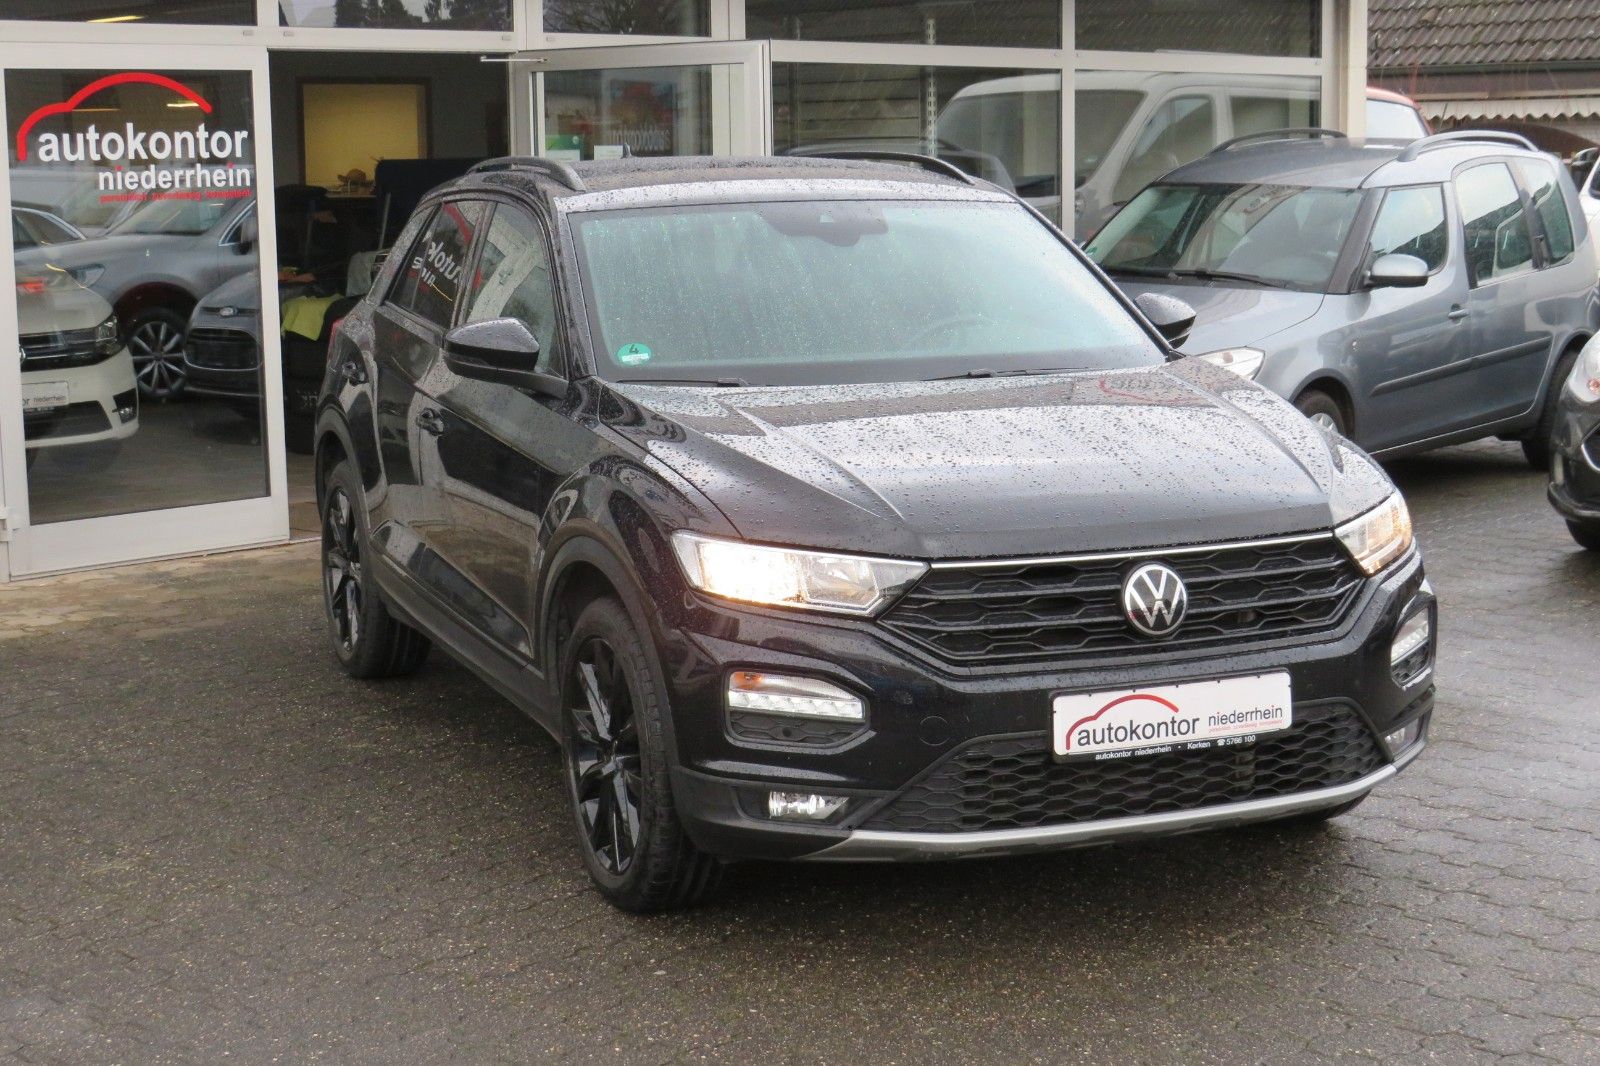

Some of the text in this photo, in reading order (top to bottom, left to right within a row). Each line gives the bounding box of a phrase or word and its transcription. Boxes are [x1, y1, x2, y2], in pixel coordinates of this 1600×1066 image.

[38, 122, 249, 162] autokontor
[99, 162, 251, 191] niederrhein
[629, 343, 640, 354] 4
[1127, 566, 1185, 629] VW
[1077, 715, 1200, 747] autokontor
[1208, 704, 1283, 727] niederrhein
[1095, 750, 1132, 760] autokontor
[1134, 745, 1172, 756] niederrhein
[1244, 734, 1256, 743] 100
